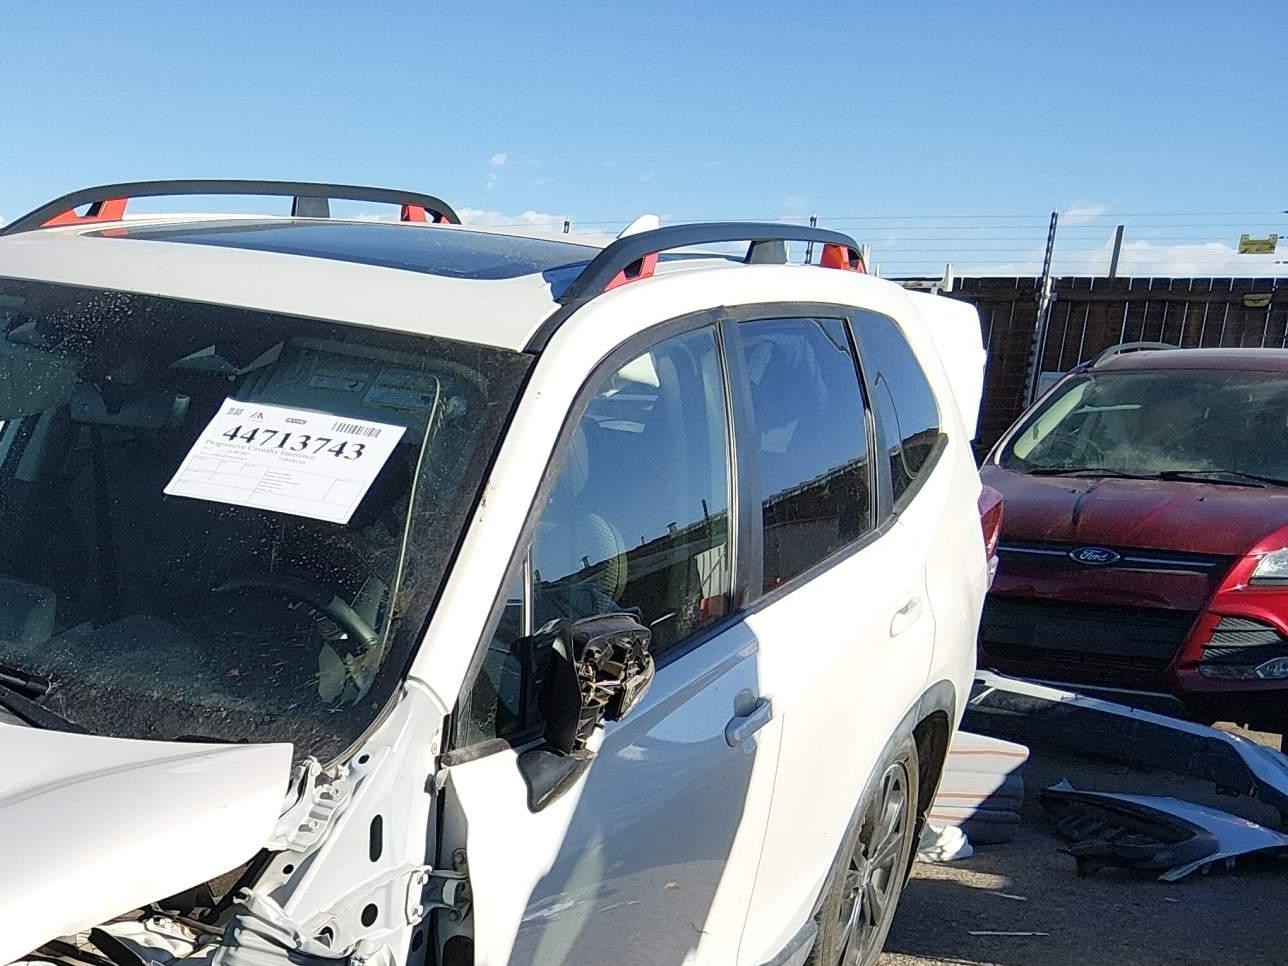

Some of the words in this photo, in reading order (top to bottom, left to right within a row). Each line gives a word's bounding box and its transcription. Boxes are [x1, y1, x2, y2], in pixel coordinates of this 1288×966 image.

[222, 424, 366, 461] 44713743
[247, 445, 279, 455] Casualty
[1079, 549, 1109, 562] Ford
